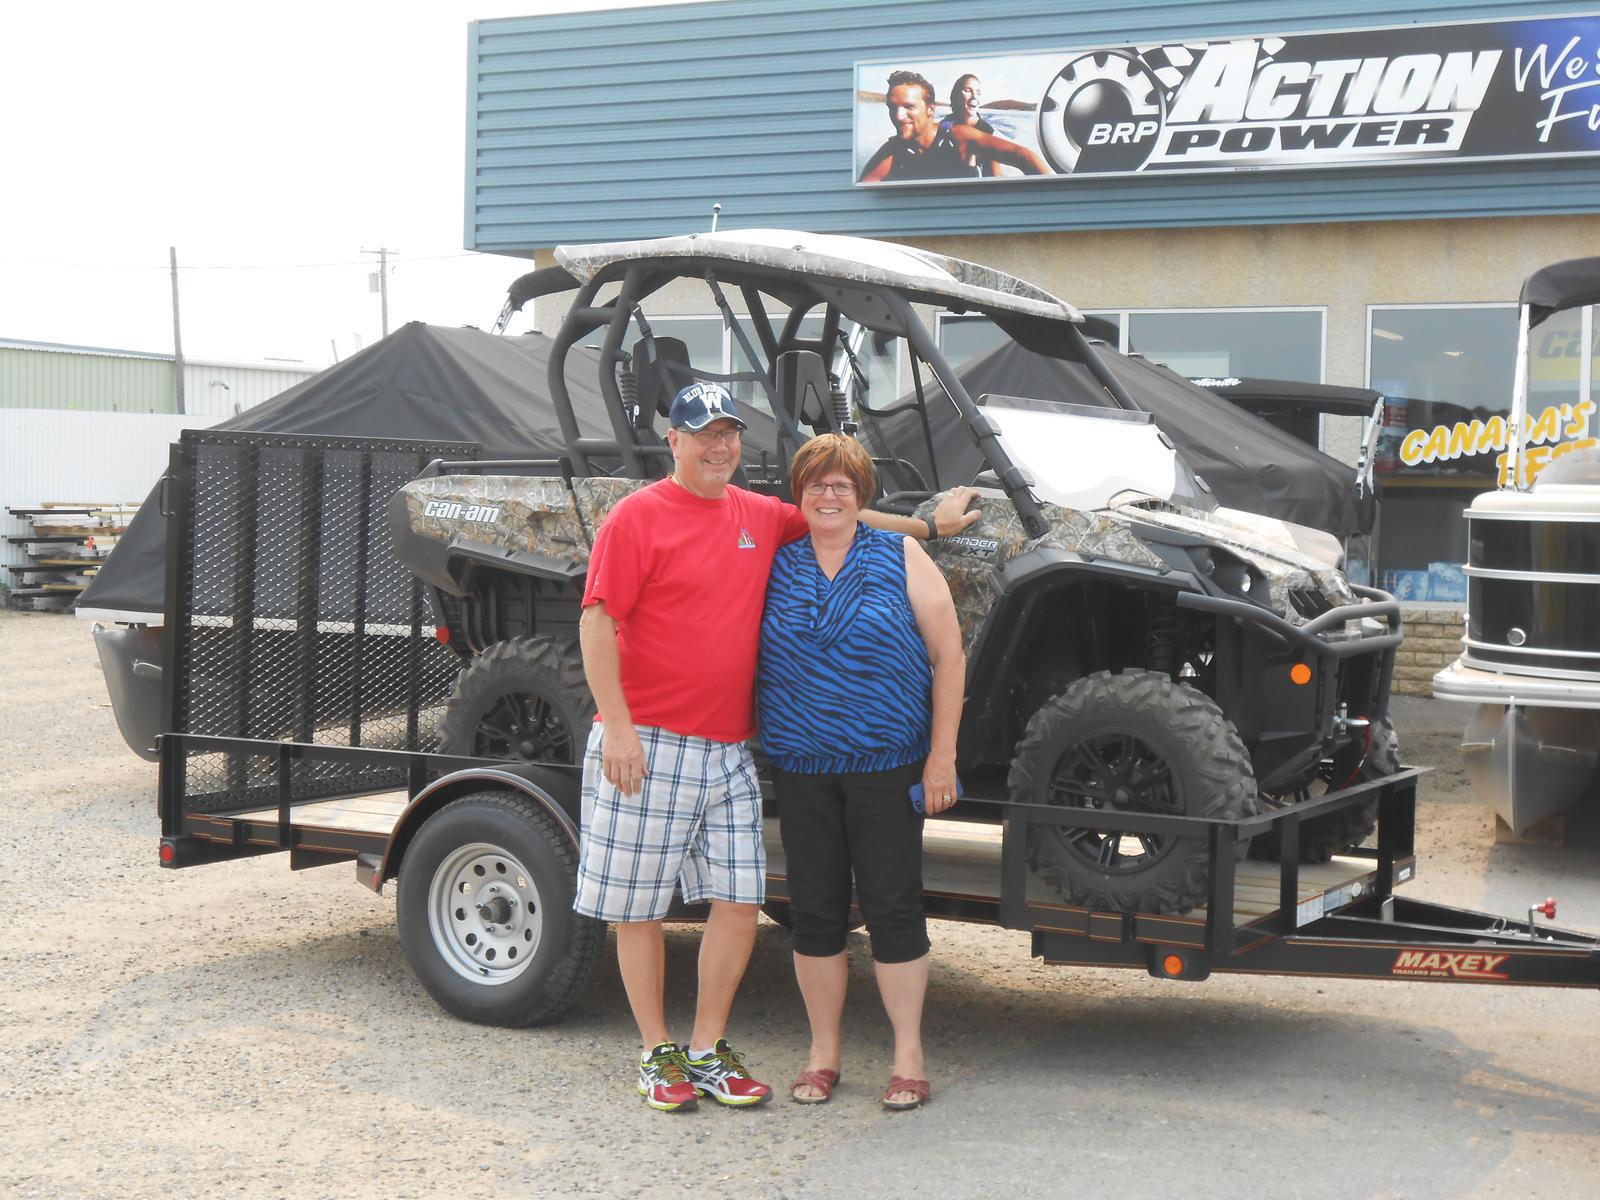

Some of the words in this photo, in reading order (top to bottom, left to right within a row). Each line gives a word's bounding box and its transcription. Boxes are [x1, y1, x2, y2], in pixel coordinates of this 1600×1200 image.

[1515, 36, 1588, 92] We
[1166, 40, 1503, 123] ACTION
[1087, 120, 1159, 145] BRP
[1165, 117, 1455, 156] POWER
[424, 500, 500, 523] can-am
[966, 547, 994, 557] XT
[1395, 951, 1508, 978] MAXEY
